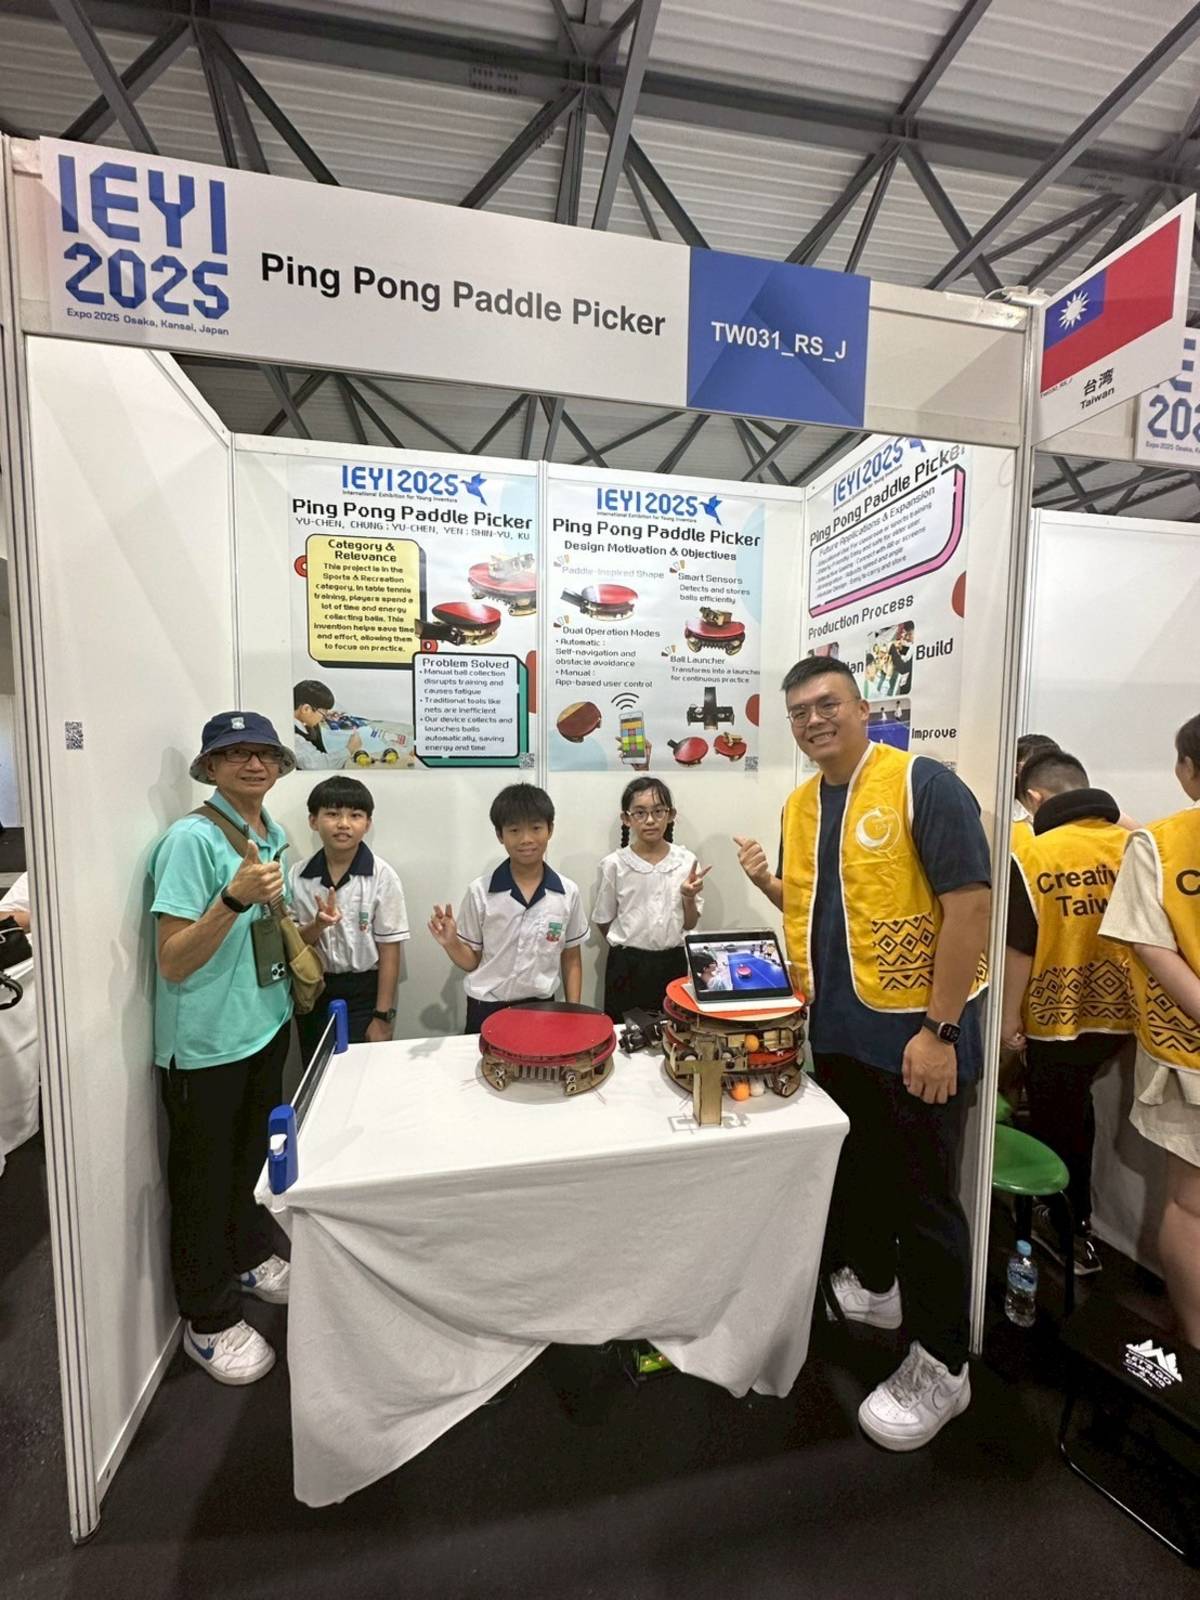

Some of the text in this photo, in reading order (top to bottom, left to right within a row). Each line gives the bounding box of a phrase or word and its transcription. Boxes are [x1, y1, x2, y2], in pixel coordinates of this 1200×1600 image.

[58, 154, 228, 256] IEYI
[64, 242, 230, 320] 2025
[261, 252, 667, 336] Ping Pong Paddle Picker
[66, 307, 230, 336] Expo 2025 Osaka, Kansai, Japan
[711, 321, 847, 362] TW031_RS_J
[1084, 367, 1115, 397] 台湾
[1080, 387, 1115, 409] Taiwan
[293, 498, 533, 529] Ping Pong Paddle Picker
[809, 523, 832, 547] Ping
[833, 506, 862, 533] Pong
[864, 474, 911, 514] Paddle
[819, 539, 839, 556] Future
[839, 516, 881, 546] Applications
[889, 486, 936, 518] Expansion
[295, 517, 345, 529] YU-CHEN,
[392, 523, 438, 535] YU-CHEN,
[518, 532, 530, 541] KU
[553, 518, 761, 547] Ping Pong Paddle Picker
[328, 539, 395, 552] Category &
[564, 540, 737, 561] Design Motivation & Objectives
[335, 550, 397, 562] Relevance
[343, 564, 371, 573] project
[636, 569, 665, 579] Shape
[323, 572, 351, 581] Sports
[360, 575, 404, 583] Recreation
[678, 572, 743, 584] Smart Sensors
[679, 584, 709, 593] Detects
[349, 594, 380, 603] players
[700, 595, 736, 604] efficiently
[378, 606, 407, 614] energy
[325, 614, 363, 622] collecting
[808, 594, 915, 641] Production Process
[353, 624, 376, 632] helps
[562, 626, 661, 638] Dual Operation Modes
[360, 635, 393, 643] allowing
[560, 638, 601, 646] Automatic
[371, 645, 406, 653] practice.
[555, 648, 619, 657] Self-navigation
[916, 638, 954, 661] Build
[422, 658, 510, 669] Problem Solved
[593, 659, 636, 667] avoidance
[687, 656, 726, 665] Launcher
[560, 669, 591, 677] Manual
[671, 666, 711, 674] Transforms
[424, 678, 457, 686] disrupts
[458, 679, 488, 687] training
[555, 678, 602, 687] App-based
[911, 727, 958, 741] Improve
[1036, 864, 1121, 895] Creativ
[1055, 893, 1110, 918] Taiw
[1125, 1358, 1166, 1388] CAMPING
[1155, 1370, 1172, 1385] GO
